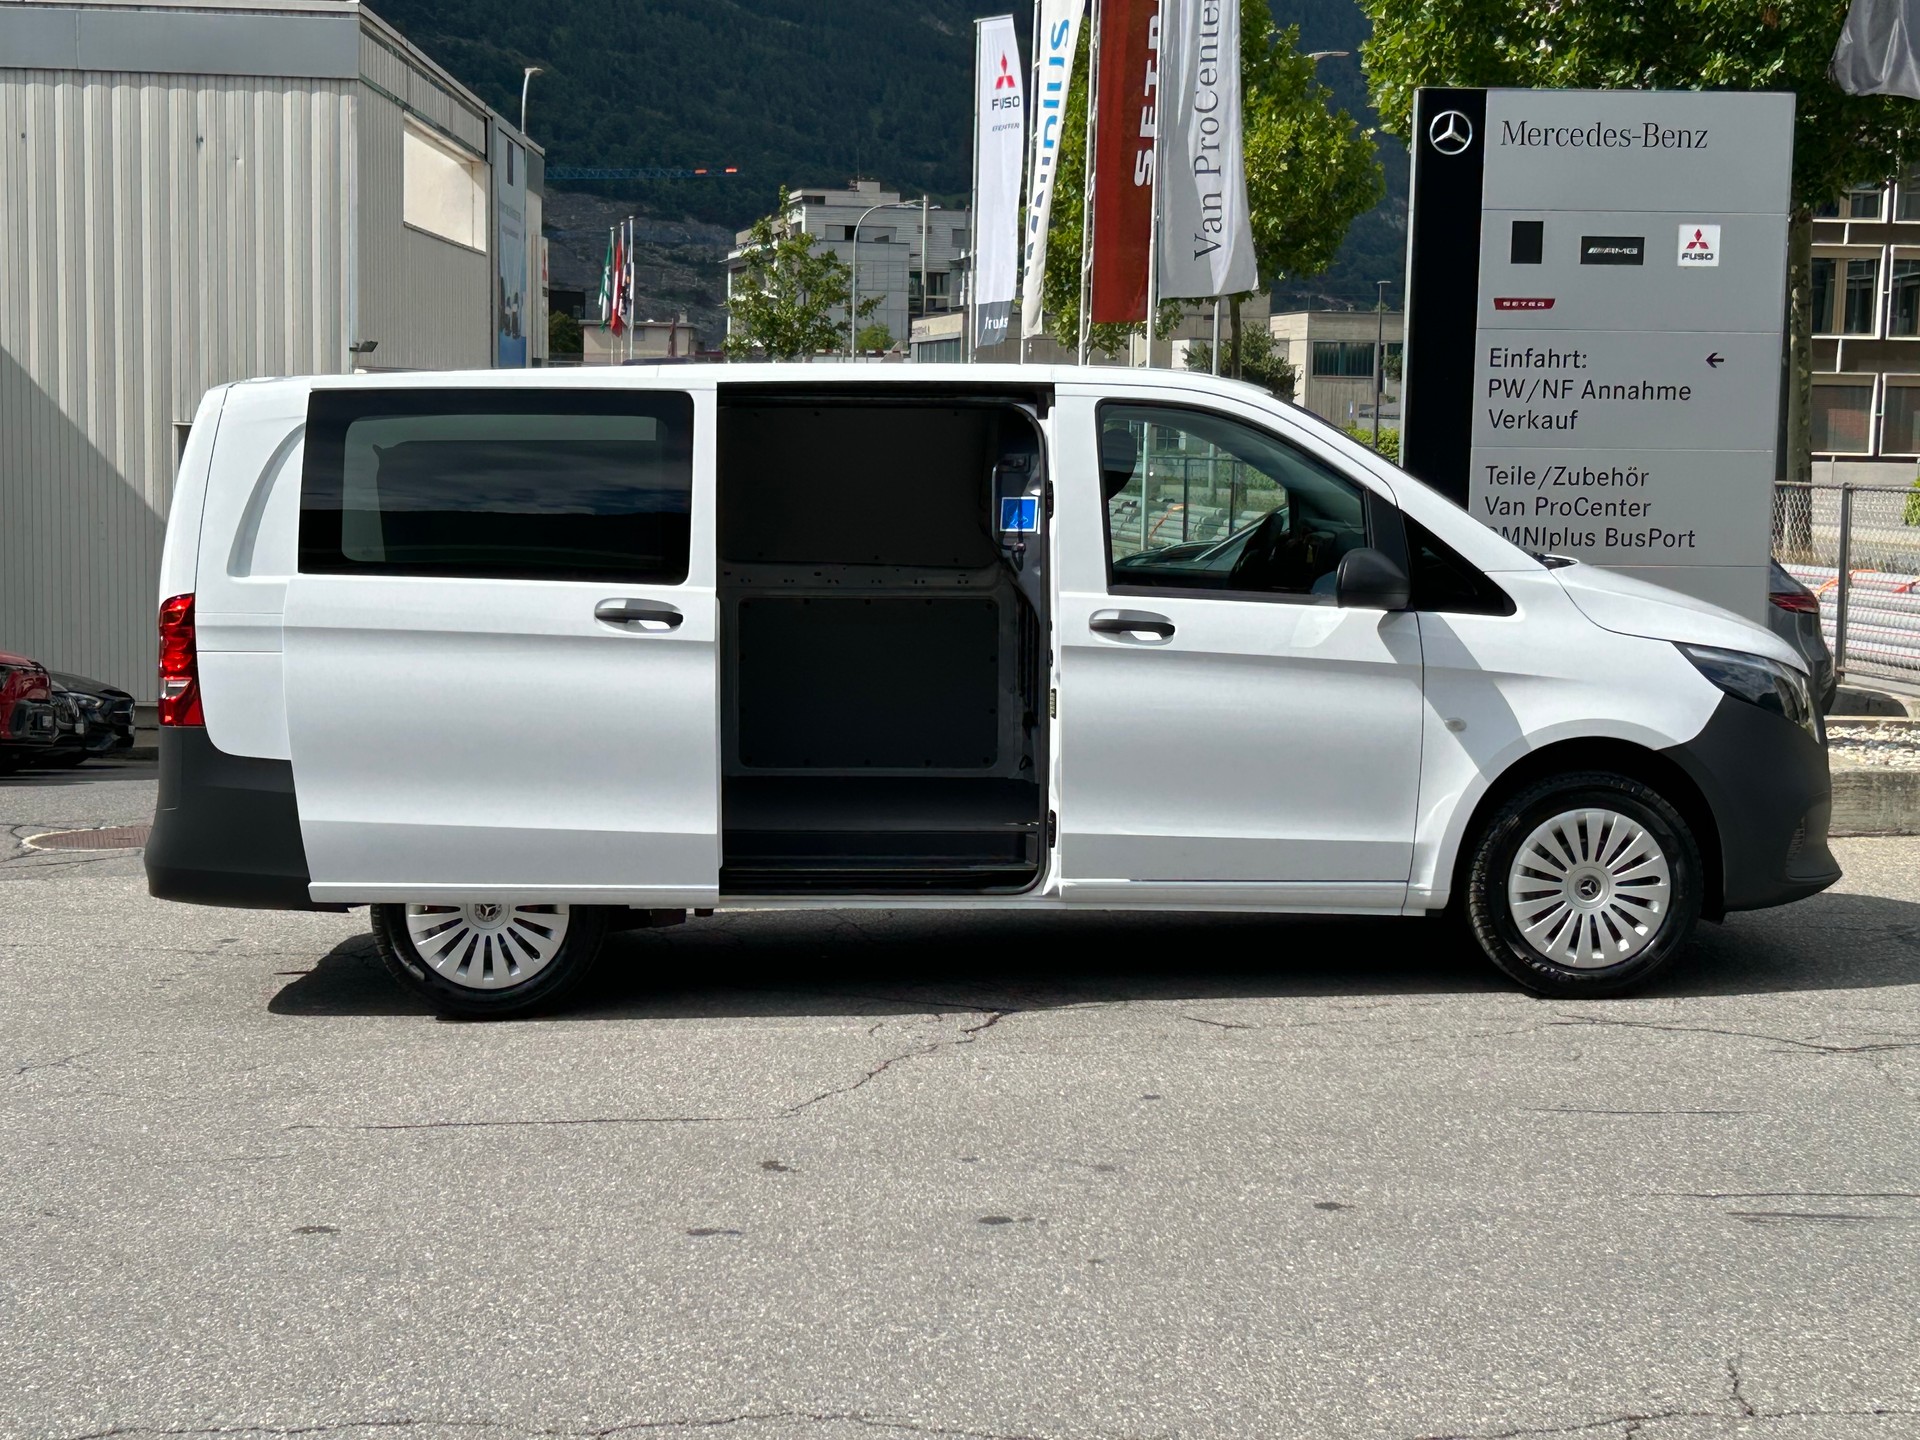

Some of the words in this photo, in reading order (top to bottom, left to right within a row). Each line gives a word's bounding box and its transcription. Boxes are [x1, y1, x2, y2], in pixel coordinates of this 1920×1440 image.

[1194, 0, 1222, 177] ProCente
[992, 95, 1020, 111] FUSO
[1500, 120, 1709, 149] Mercedes-Benz
[1193, 191, 1222, 261] Van
[1681, 252, 1714, 261] FUSO
[1489, 347, 1588, 369] Einfahrt:
[1488, 379, 1574, 403] PW/NF
[1581, 380, 1692, 401] Annahme
[1488, 408, 1579, 430] Verkauf
[1485, 465, 1650, 487] Teile/Zubehör
[1484, 496, 1525, 517] Van
[1535, 497, 1652, 518] ProCenter
[1605, 527, 1696, 548] BusPort
